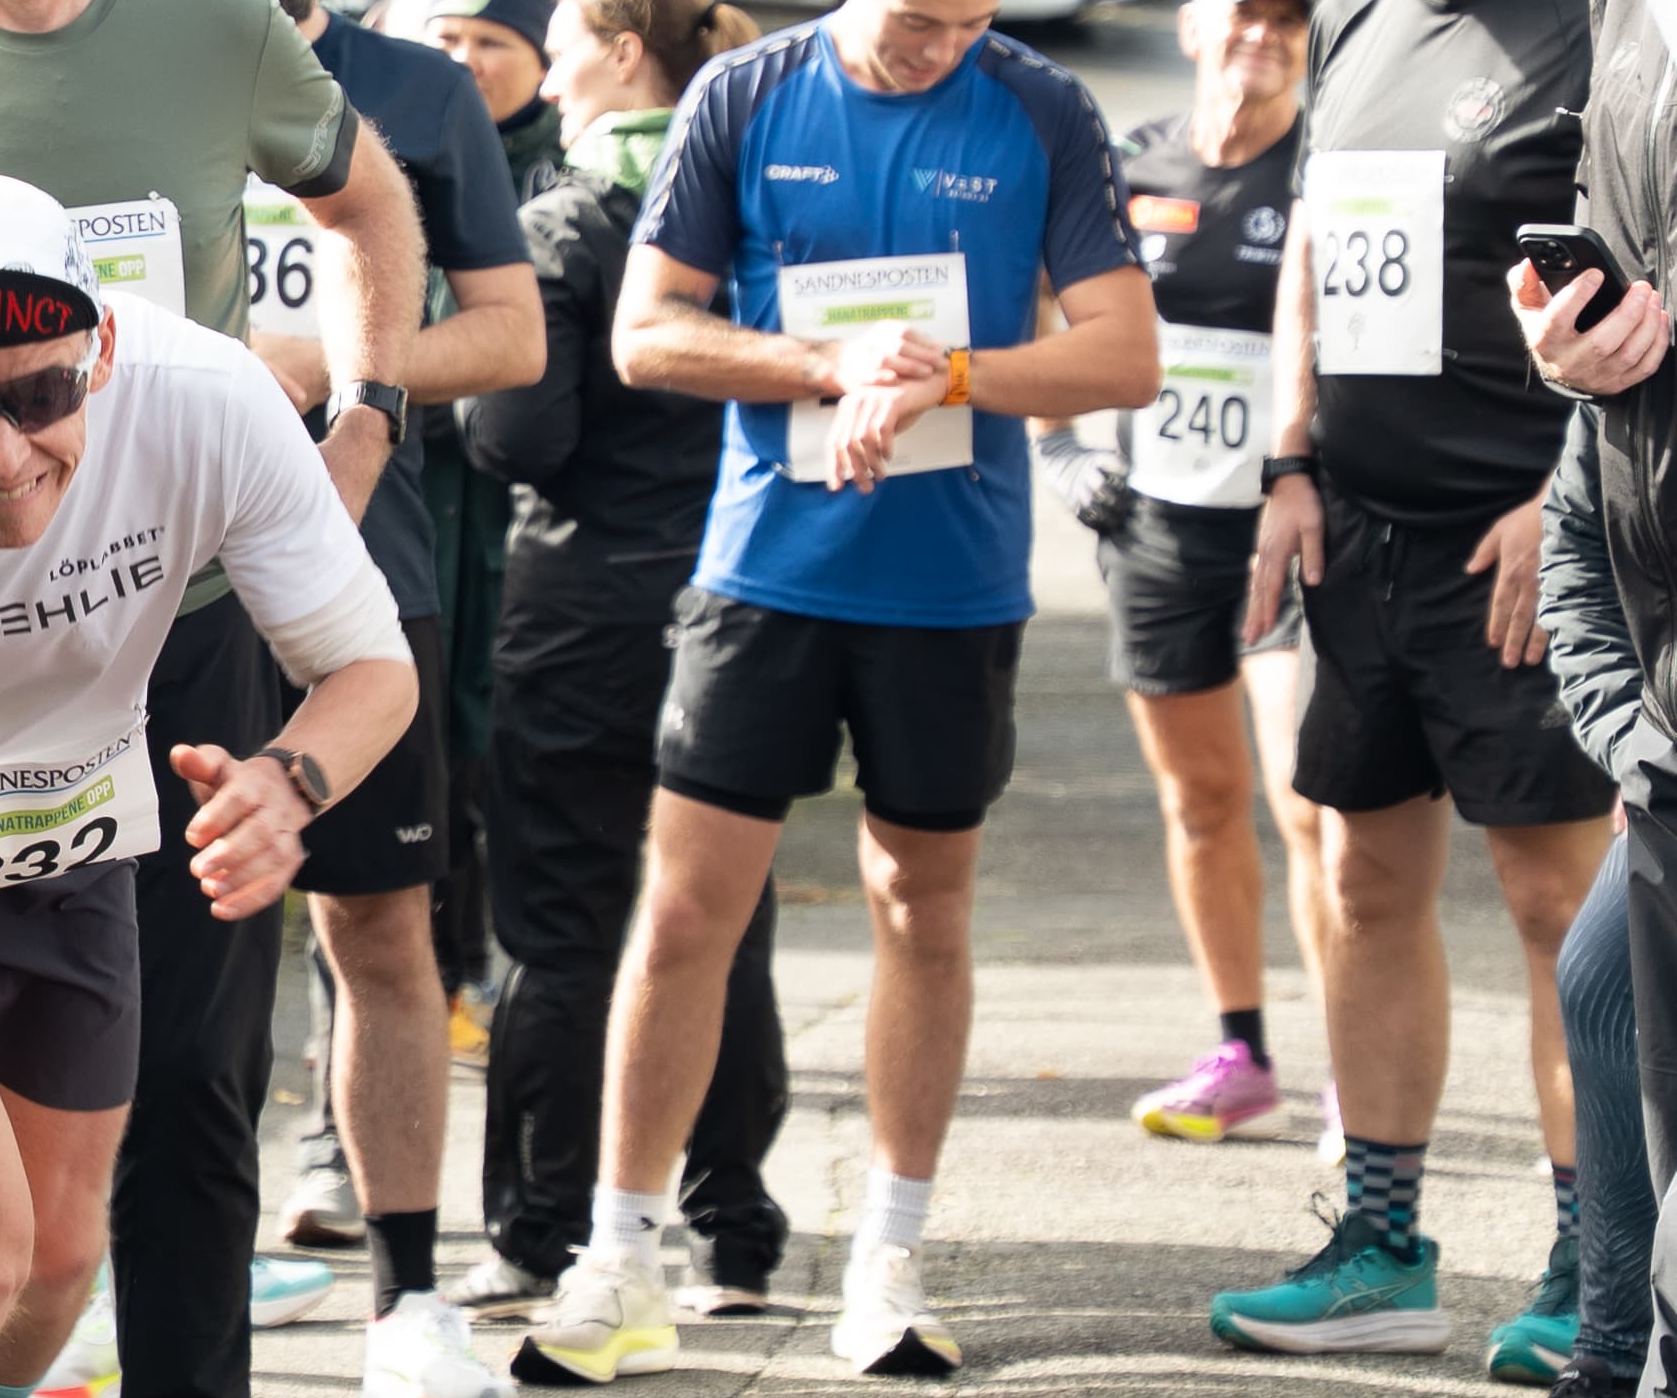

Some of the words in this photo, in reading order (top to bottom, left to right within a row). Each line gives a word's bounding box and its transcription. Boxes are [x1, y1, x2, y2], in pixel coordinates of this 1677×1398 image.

[1323, 229, 1408, 297] 238
[1158, 389, 1249, 449] 240
[86, 781, 112, 805] OPP
